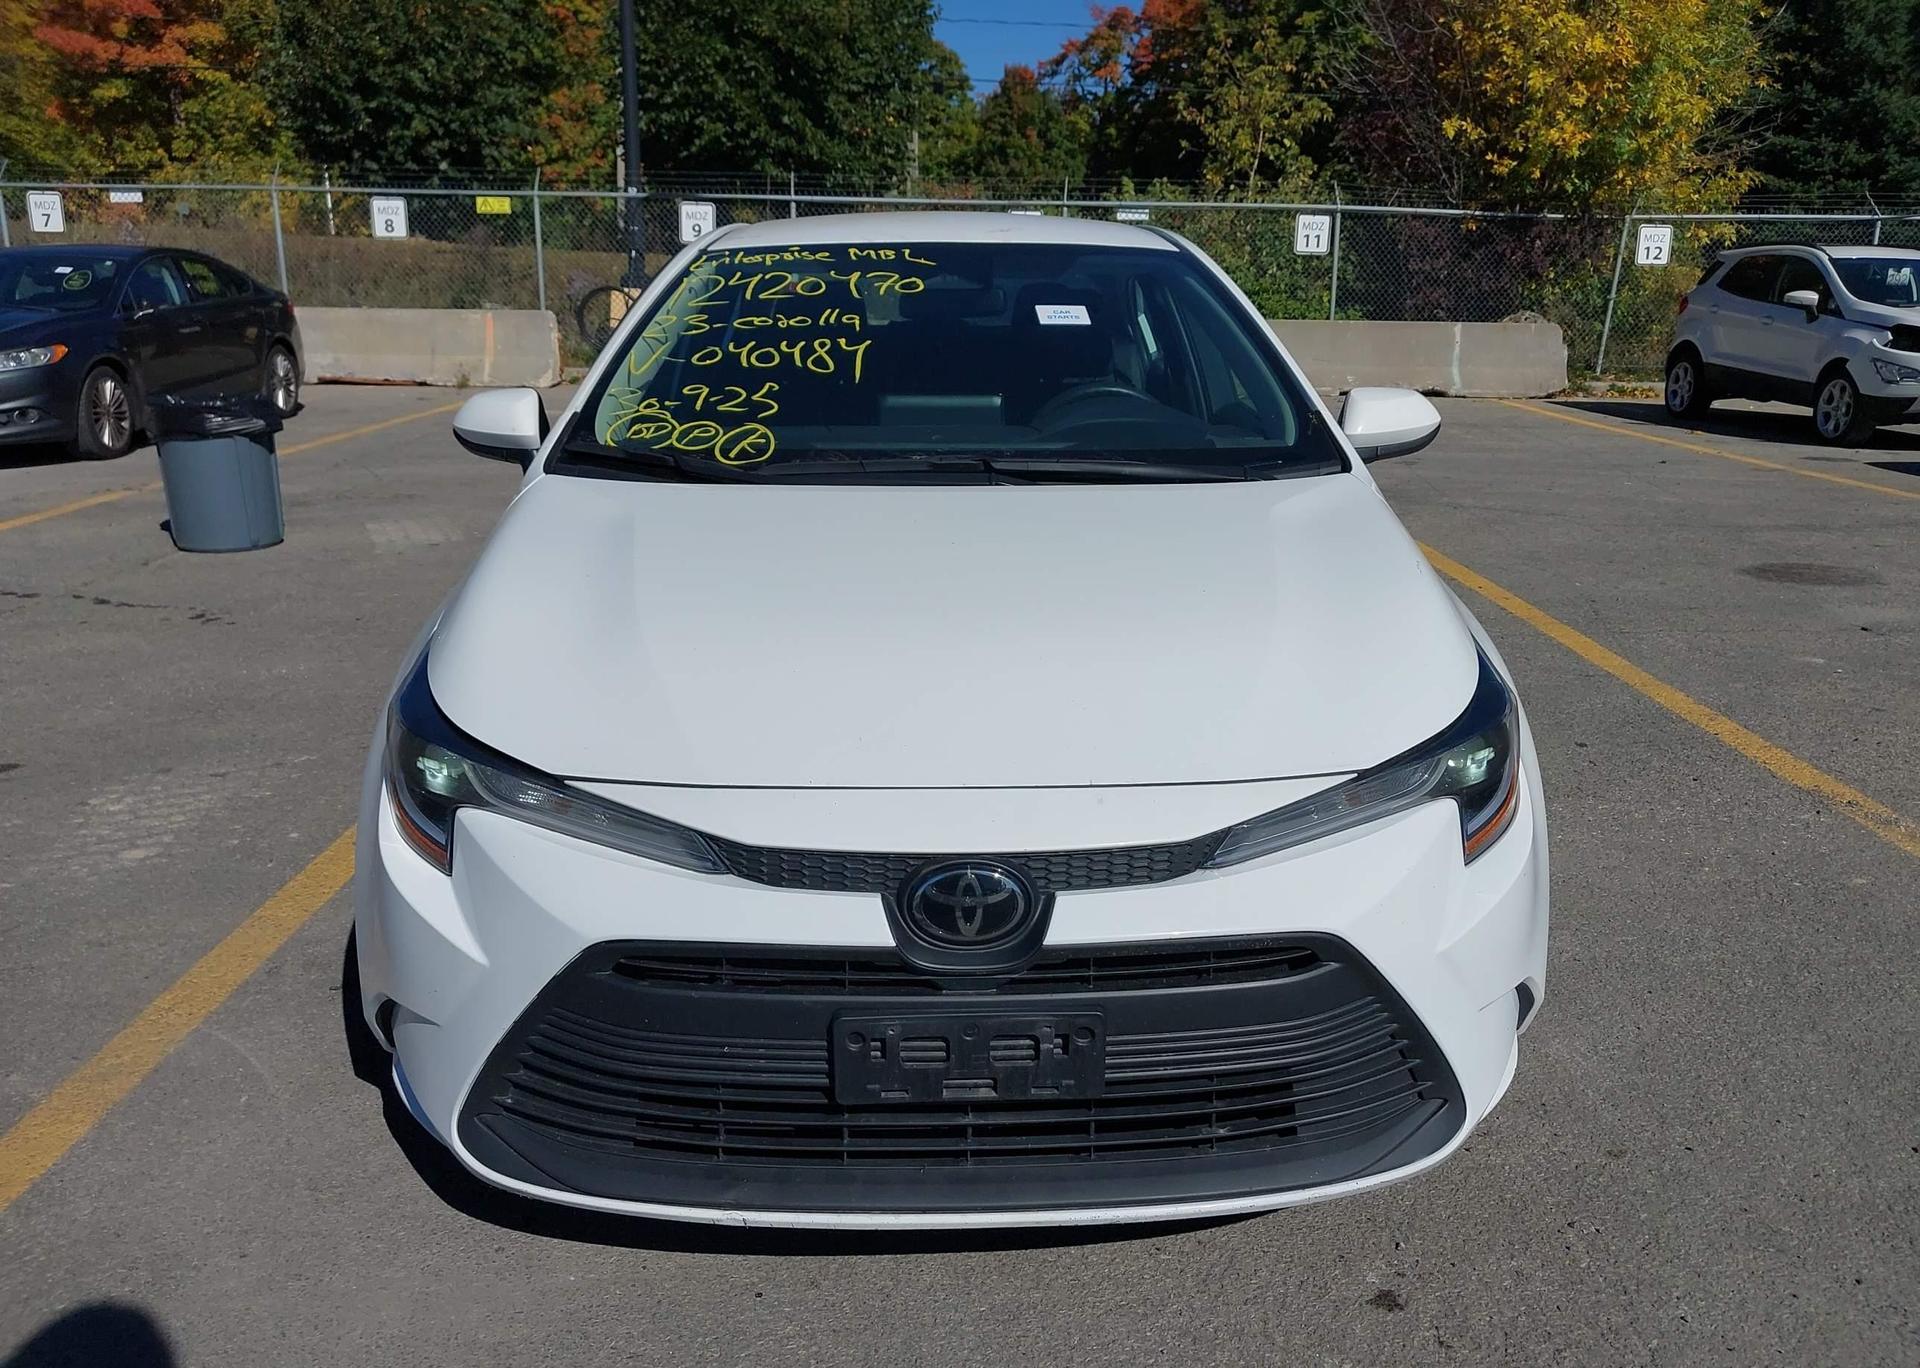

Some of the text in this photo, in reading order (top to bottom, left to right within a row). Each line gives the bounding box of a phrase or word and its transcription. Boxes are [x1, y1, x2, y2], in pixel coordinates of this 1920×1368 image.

[34, 200, 57, 211] MDZ
[377, 206, 400, 216] MDZ
[41, 213, 51, 228] 7
[685, 210, 709, 221] MDZ
[384, 218, 395, 233] 8
[692, 223, 702, 238] 9
[1302, 221, 1325, 231] MDZ
[1303, 233, 1321, 249] 11
[1644, 233, 1666, 243] MDZ
[1643, 246, 1663, 260] 12
